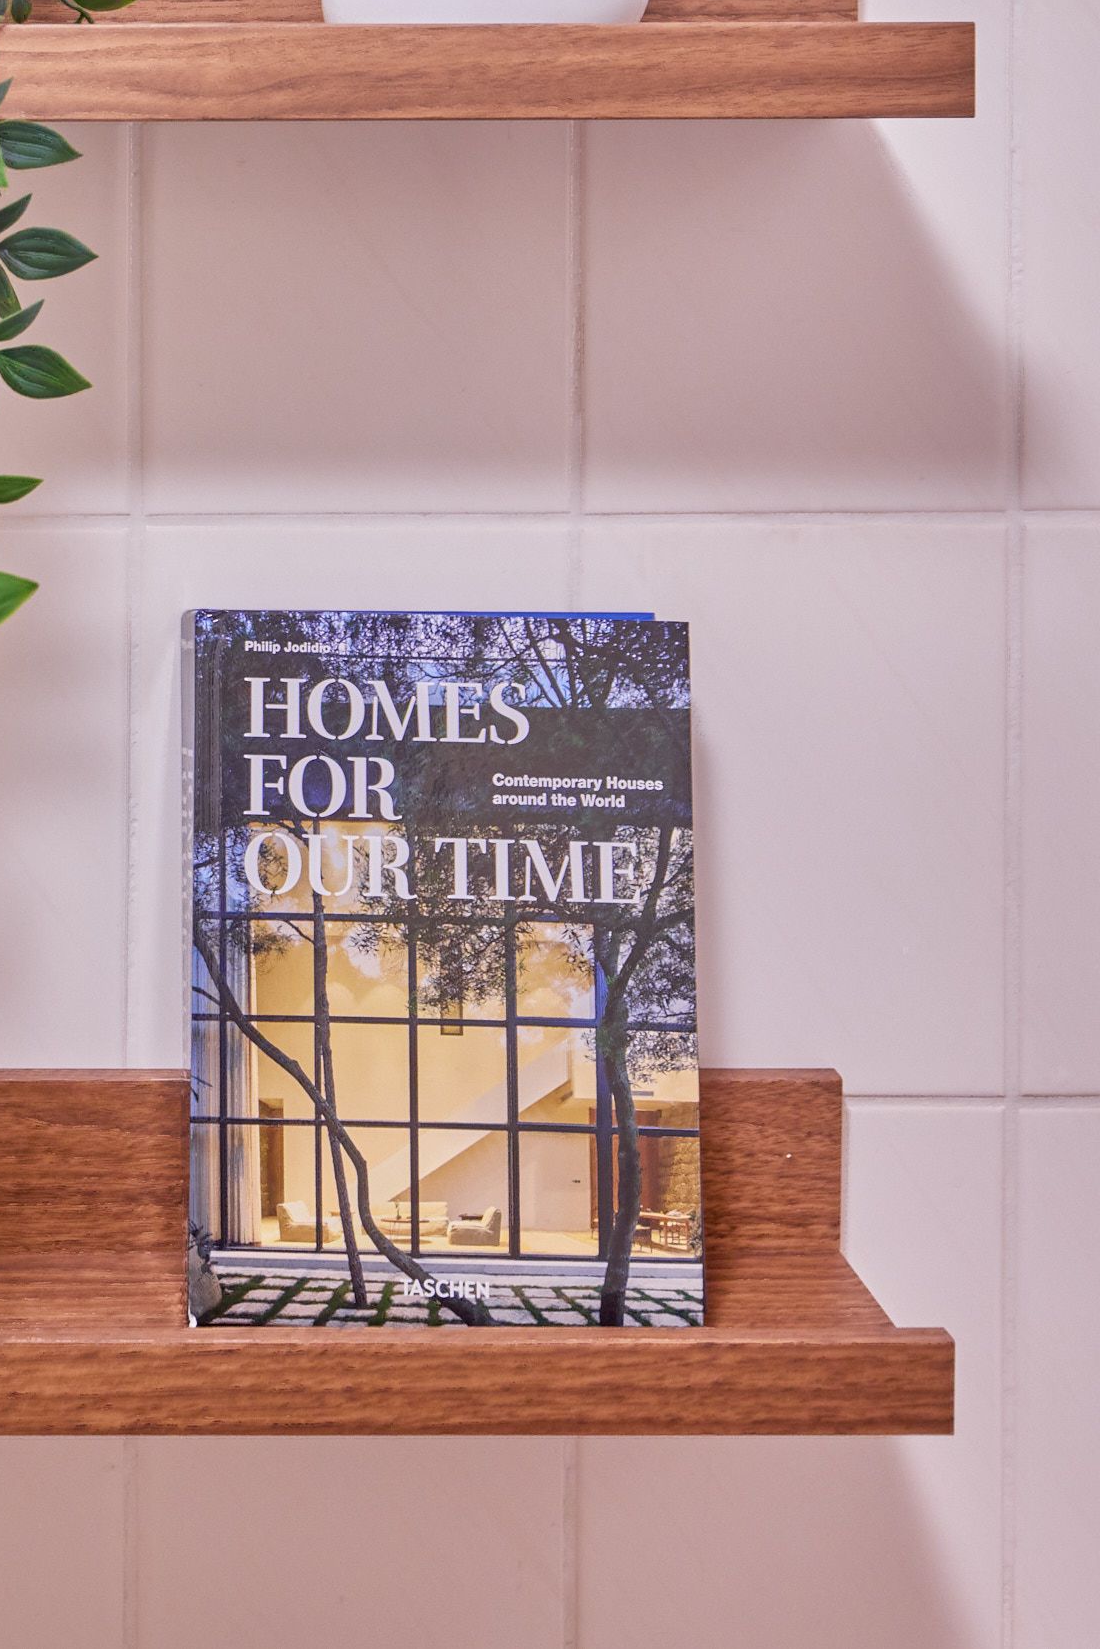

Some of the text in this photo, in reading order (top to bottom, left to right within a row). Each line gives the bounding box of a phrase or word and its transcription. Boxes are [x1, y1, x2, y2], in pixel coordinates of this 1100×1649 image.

[244, 640, 331, 654] Philip Jodidio
[243, 677, 530, 744] HOMES
[243, 754, 402, 821] FOR
[492, 773, 664, 791] Contemporary Houses
[492, 793, 626, 808] around the World
[244, 832, 641, 904] OUR TIME
[400, 1278, 490, 1299] TASCHEN
